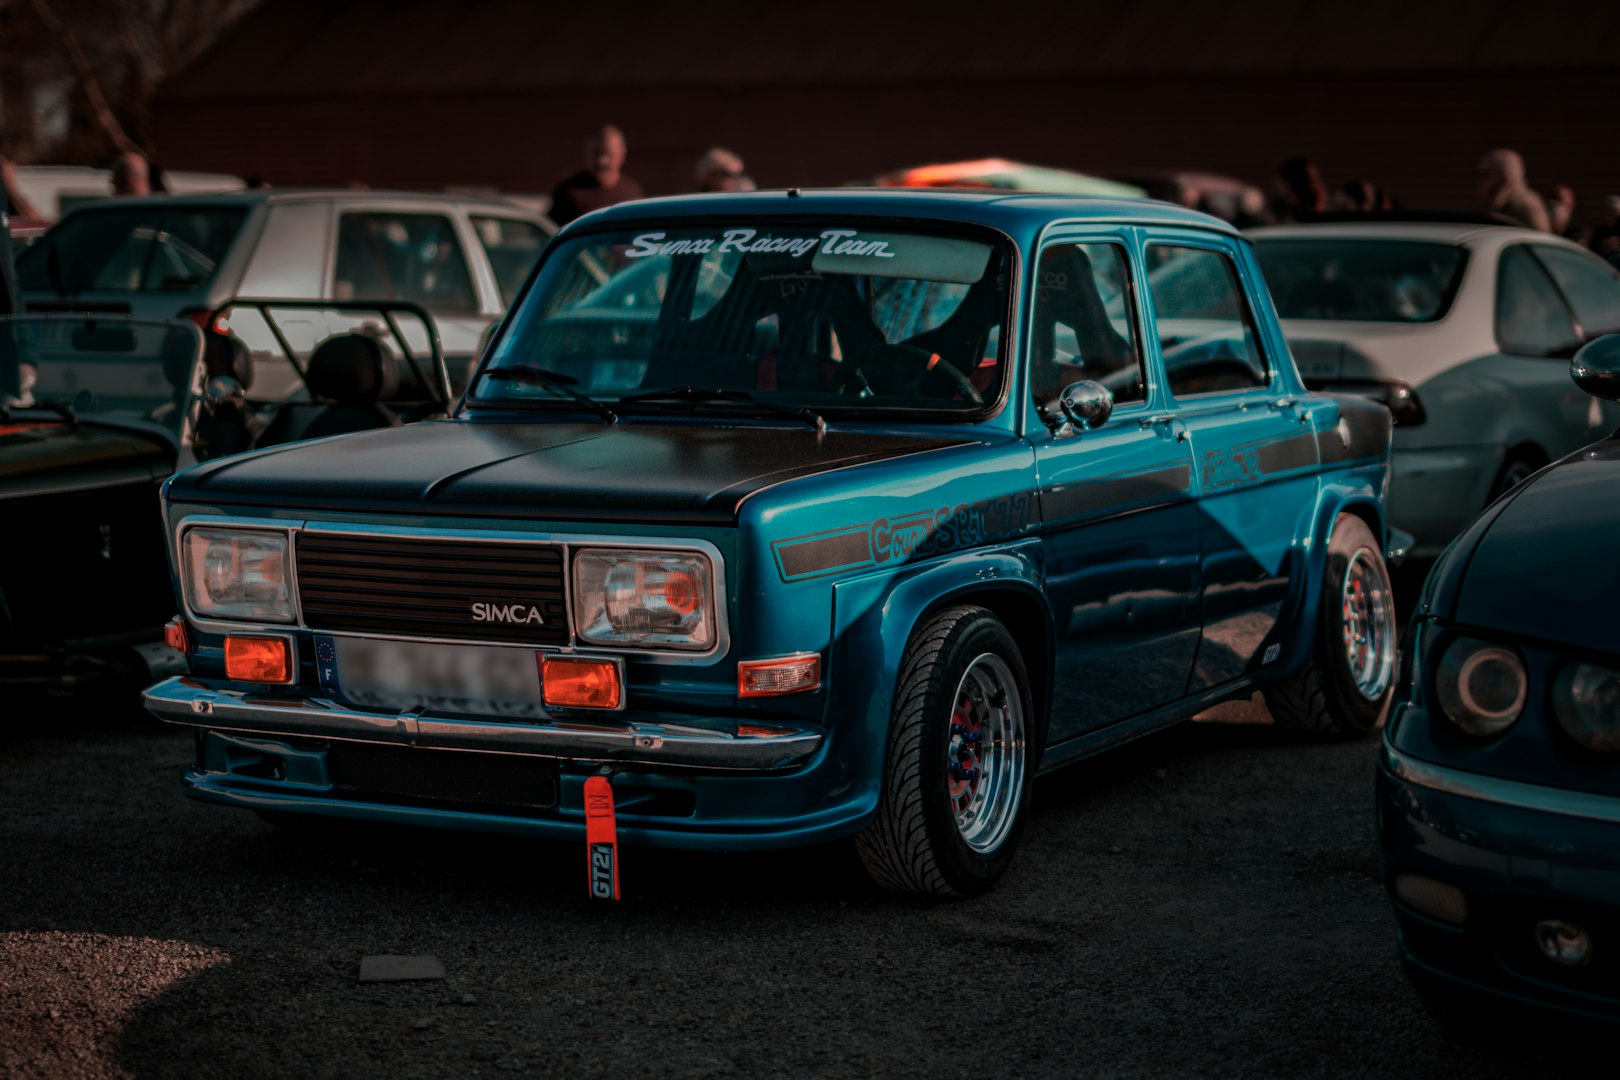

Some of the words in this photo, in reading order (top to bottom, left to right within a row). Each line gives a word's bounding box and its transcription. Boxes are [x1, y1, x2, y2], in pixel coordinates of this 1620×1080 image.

[625, 232, 713, 258] Simca
[717, 228, 820, 258] Racing
[820, 230, 895, 258] Team
[471, 601, 545, 626] SIMCA
[324, 668, 332, 681] F
